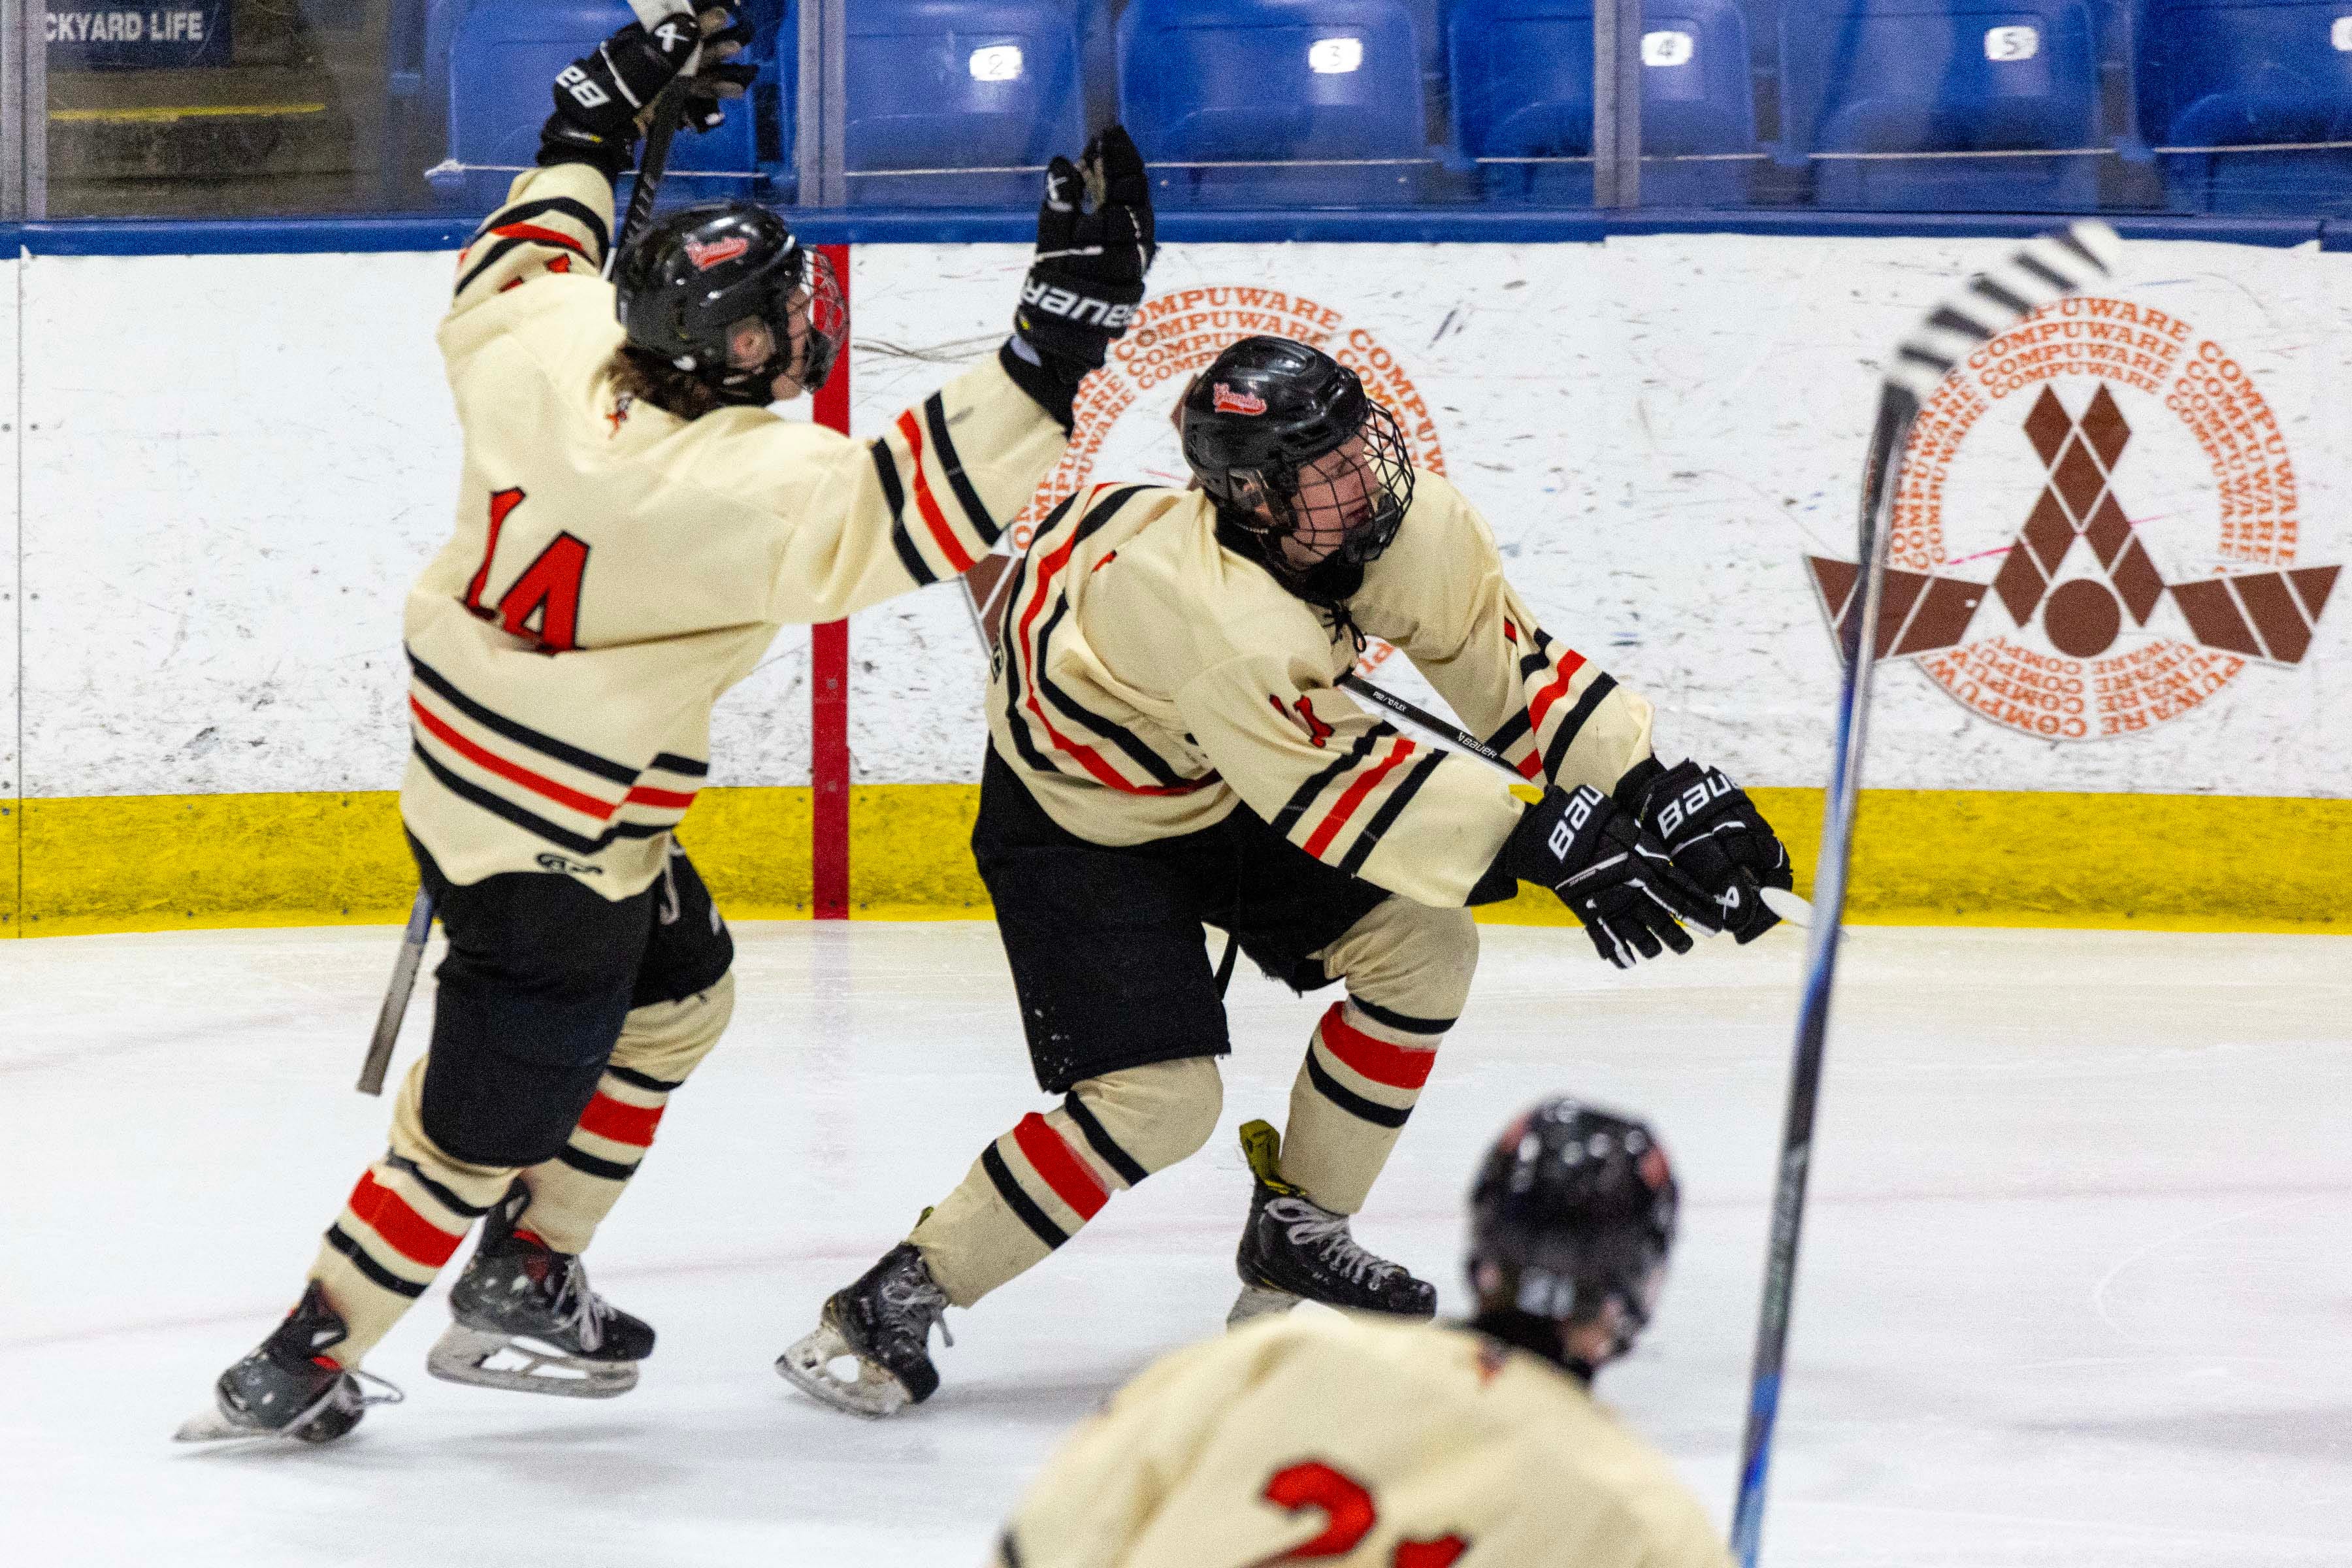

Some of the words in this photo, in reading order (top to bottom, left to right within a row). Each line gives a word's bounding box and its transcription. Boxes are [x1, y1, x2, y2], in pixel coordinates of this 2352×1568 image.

[150, 11, 204, 41] LIFE
[2002, 31, 2021, 56] 5
[1128, 286, 1343, 331] OMPUWARE
[1968, 321, 2181, 370] COMPUWARE
[1980, 342, 2171, 386] COMPUWARE
[1991, 361, 2161, 399] COMPUWARE
[2165, 393, 2234, 555] COMPUWARE
[2174, 377, 2254, 561] COMPUWARE
[2187, 359, 2274, 563] COMPUWARE
[2198, 339, 2298, 564] COMPUWARE
[464, 485, 592, 656] 14
